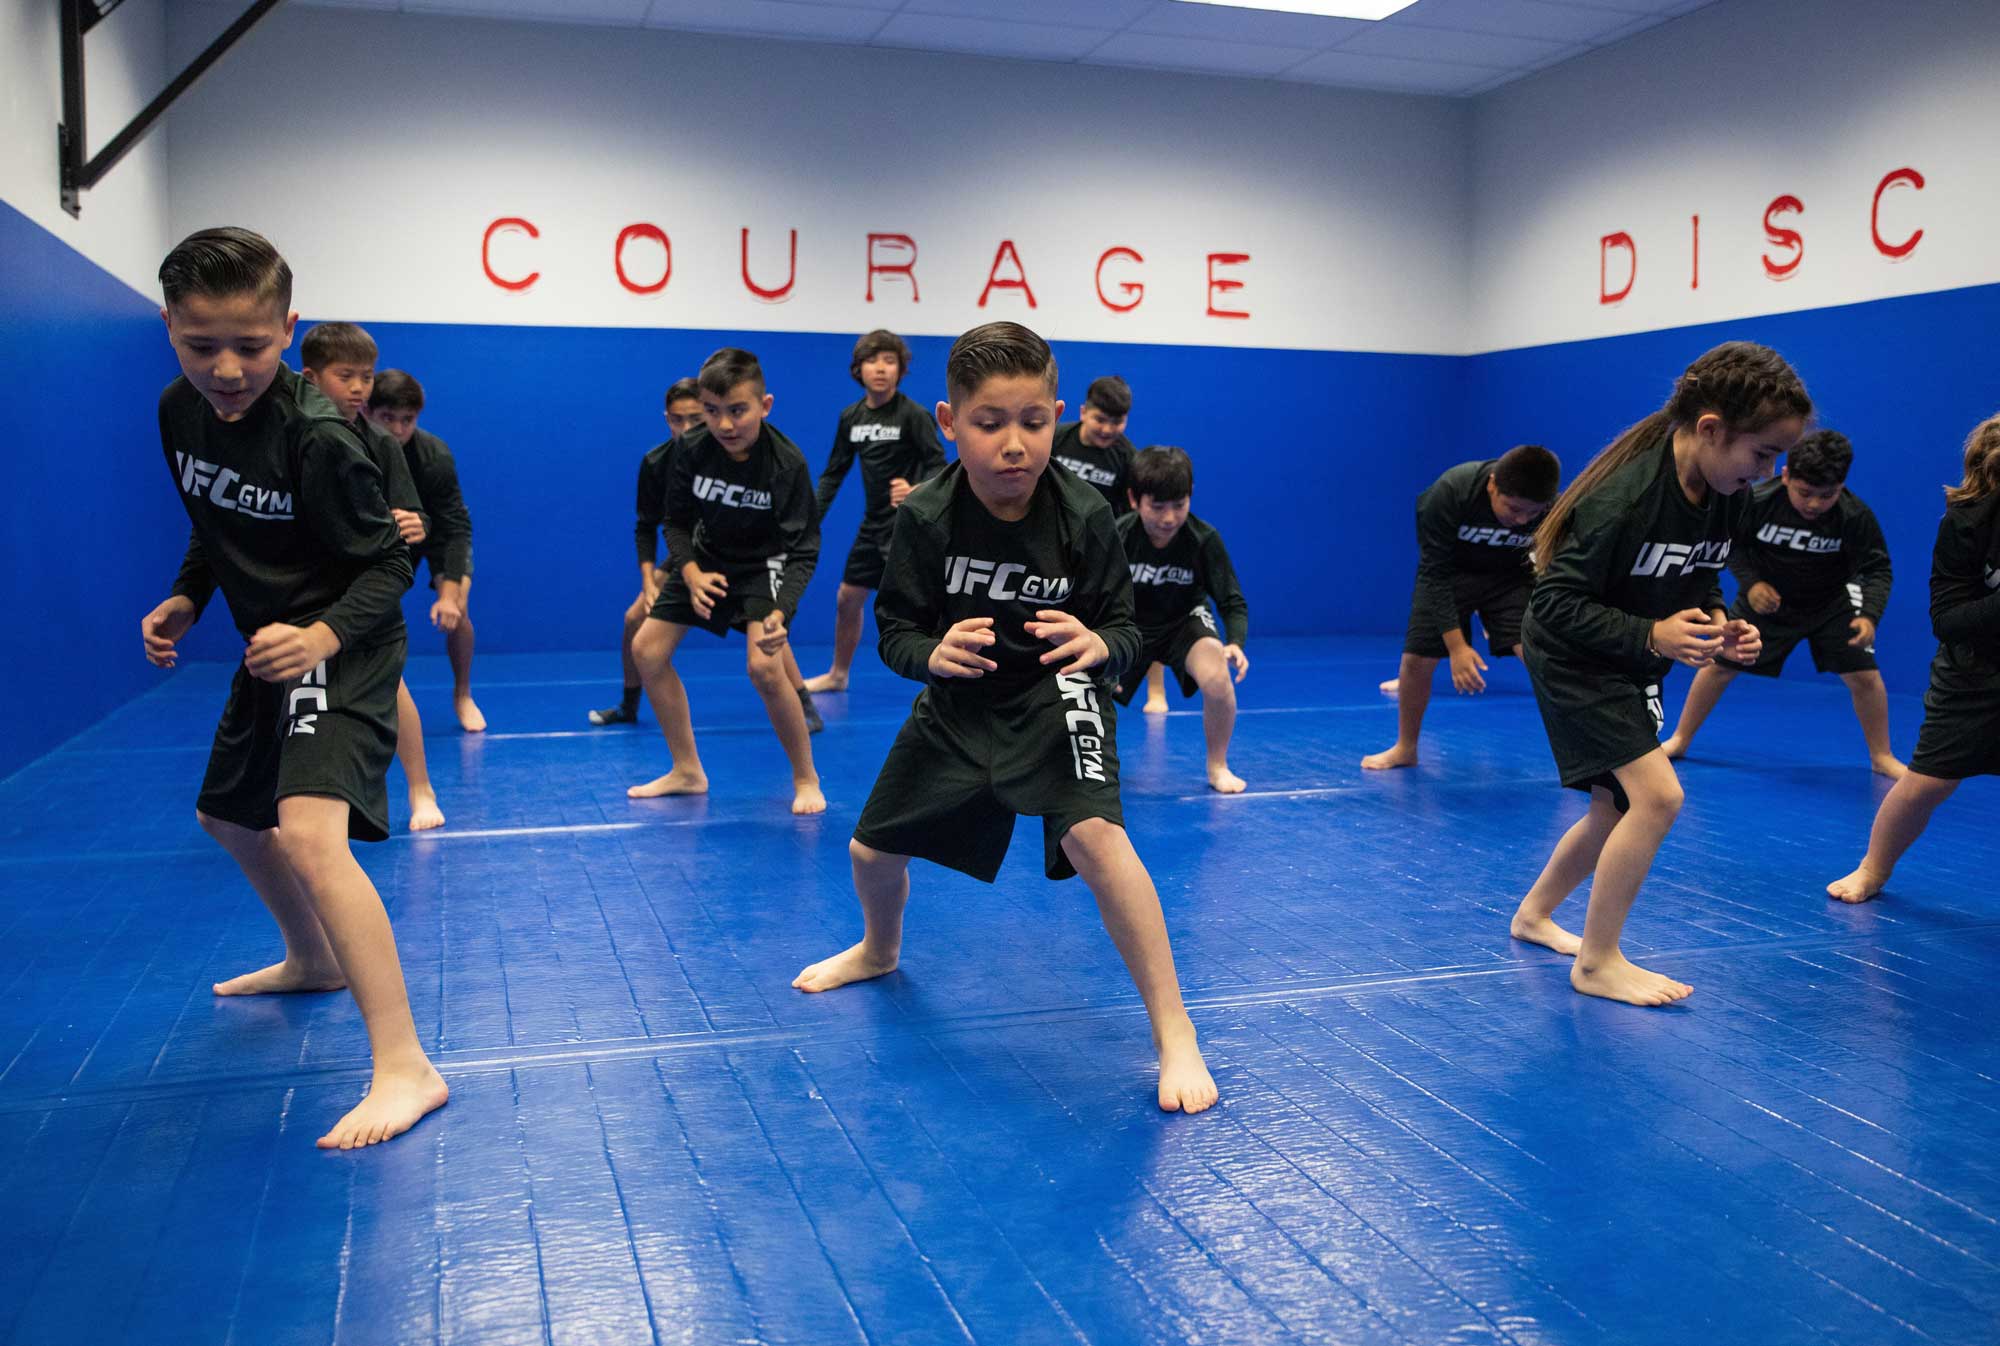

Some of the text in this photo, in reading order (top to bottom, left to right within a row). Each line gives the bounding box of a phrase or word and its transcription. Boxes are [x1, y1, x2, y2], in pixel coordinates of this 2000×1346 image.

[1600, 167, 1925, 304] DISC
[481, 217, 1251, 319] COURAGE
[850, 424, 881, 442] UFC
[238, 485, 293, 514] GYM
[692, 475, 772, 508] UFC GYM
[1458, 525, 1511, 546] UFC
[1757, 523, 1842, 550] UFC GYM
[945, 556, 1027, 601] UFC
[1056, 672, 1106, 782] UFC GYM
